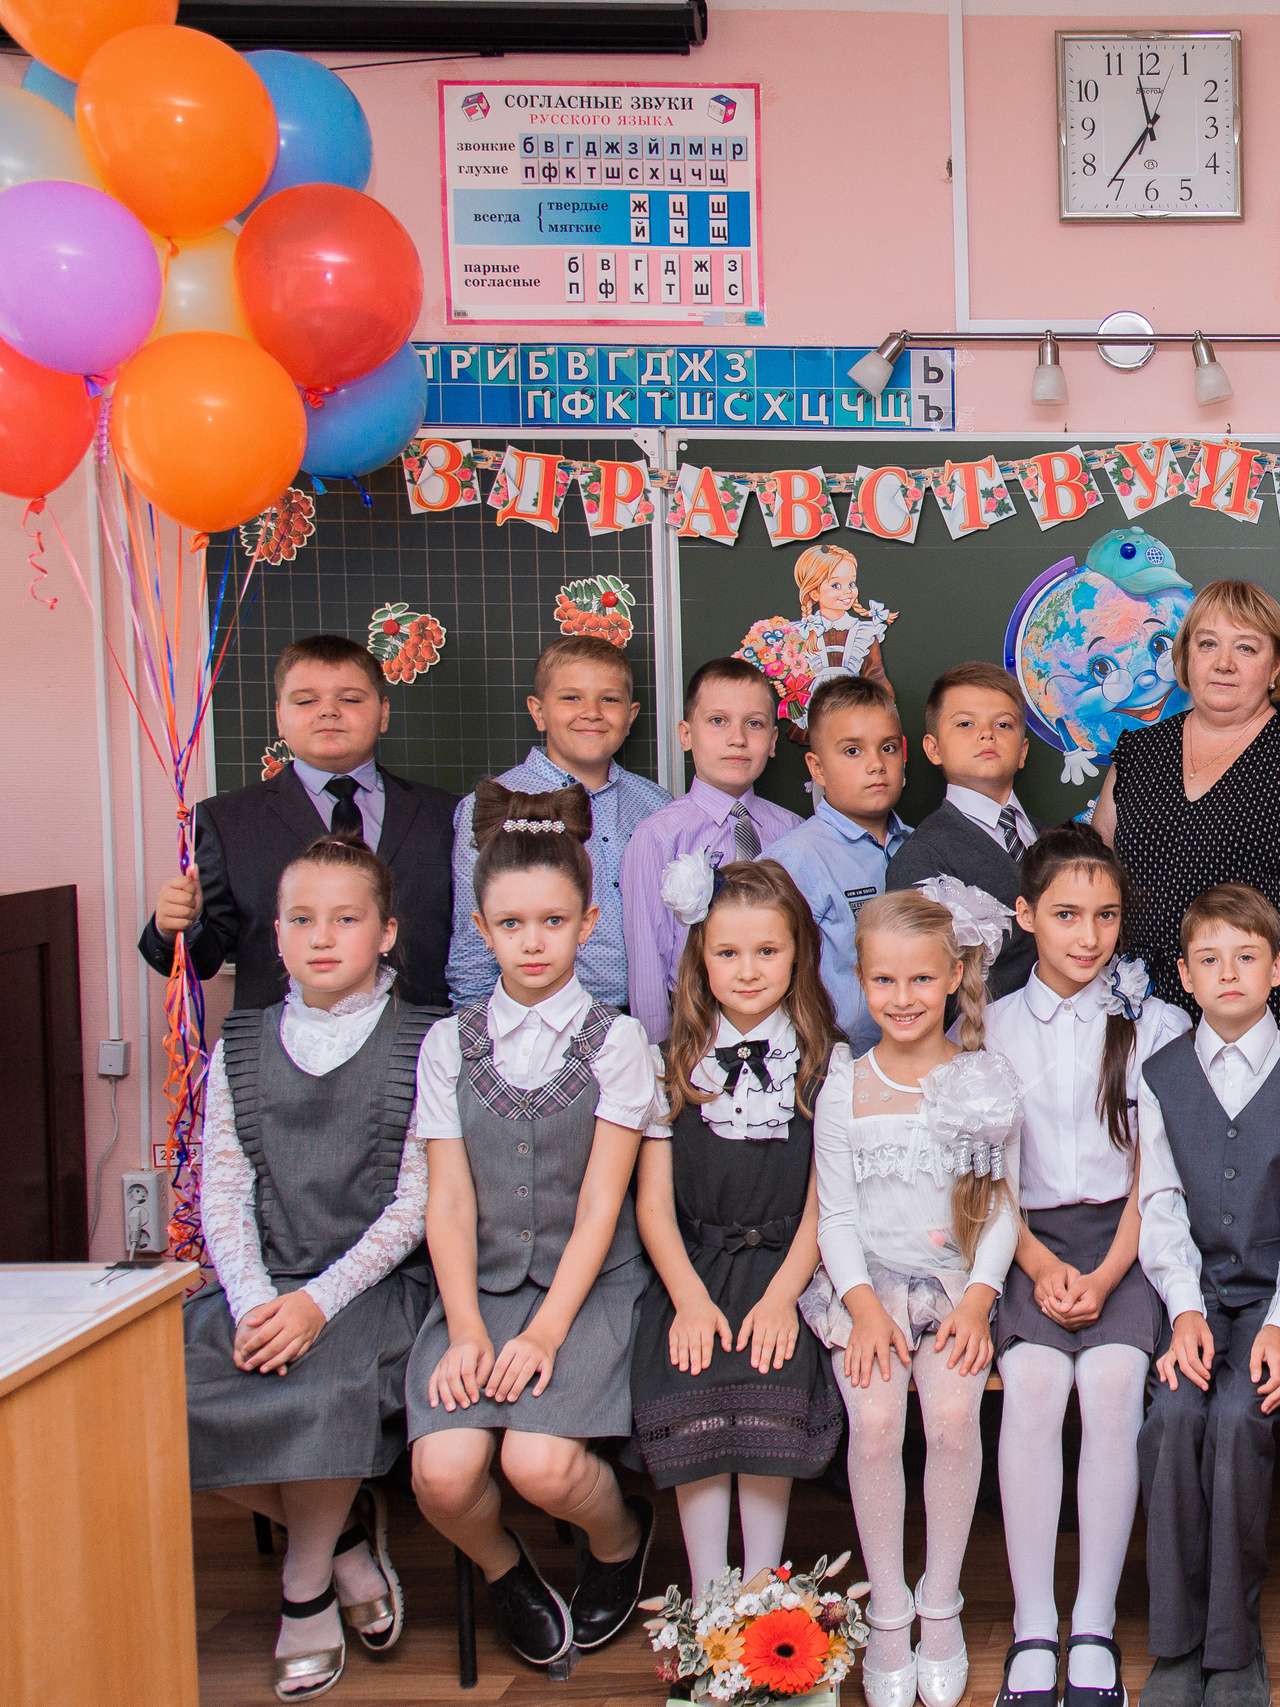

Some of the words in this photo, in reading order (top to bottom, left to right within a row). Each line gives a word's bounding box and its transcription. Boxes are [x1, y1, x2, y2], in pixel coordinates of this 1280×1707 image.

[1105, 52, 1124, 75] 11
[1137, 52, 1160, 75] 12
[1182, 52, 1189, 75] 1
[1077, 79, 1099, 102] 10
[1203, 79, 1219, 102] 2
[504, 95, 622, 109] СОГЛАСНЫЕ
[631, 96, 693, 111] ЗВУКИ
[530, 114, 611, 125] РУССКОГО
[618, 115, 674, 126] ЯЗЫКА
[1081, 117, 1096, 140] 9
[1205, 116, 1219, 139] 3
[457, 143, 516, 152] звонкие
[523, 136, 534, 154] б
[544, 141, 554, 153] в
[566, 141, 574, 154] г
[585, 142, 597, 157] д
[605, 142, 621, 154] ж
[628, 142, 639, 155] з
[648, 138, 659, 155] й
[670, 143, 680, 155] л
[689, 143, 703, 155] м
[712, 143, 722, 156] н
[732, 143, 743, 157] р
[458, 166, 509, 177] глухие
[525, 166, 535, 179] п
[542, 162, 558, 182] ф
[566, 166, 576, 179] к
[587, 167, 597, 179] т
[606, 167, 620, 179] ш
[629, 167, 639, 180] с
[649, 167, 660, 180] х
[670, 168, 682, 184] ц
[691, 168, 702, 181] ч
[710, 169, 726, 184] щ
[1082, 153, 1097, 176] 8
[1205, 152, 1220, 174] 4
[1111, 179, 1125, 201] 7
[1144, 179, 1159, 201] 6
[1179, 179, 1193, 201] 5
[474, 214, 521, 224] всегда
[547, 202, 609, 214] твердые
[632, 200, 648, 213] ж
[673, 201, 685, 217] ц
[711, 202, 726, 214] ш
[548, 224, 602, 233] мягкие
[635, 221, 646, 238] й
[674, 226, 684, 238] ч
[712, 226, 728, 241] щ
[464, 264, 520, 276] парные
[568, 256, 579, 274] б
[601, 259, 611, 271] в
[635, 259, 643, 271] г
[664, 260, 676, 275] д
[694, 260, 709, 272] ж
[728, 260, 738, 272] з
[464, 279, 541, 287] согласные
[569, 282, 580, 294] п
[599, 279, 615, 299] ф
[634, 283, 644, 295] к
[666, 283, 676, 296] т
[695, 284, 709, 296] ш
[728, 284, 738, 296] с
[451, 350, 472, 380] Р
[487, 348, 516, 381] Й
[529, 350, 550, 381] Б
[567, 351, 589, 381] В
[608, 352, 629, 381] Г
[640, 352, 672, 386] Д
[678, 352, 714, 382] Ж
[723, 352, 747, 383] З
[527, 390, 551, 419] П
[561, 390, 594, 419] Ф
[606, 391, 632, 420] К
[680, 392, 714, 420] Ш
[723, 391, 748, 421] С
[761, 392, 788, 421] Х
[802, 393, 829, 425] Ц
[841, 393, 864, 422] Ч
